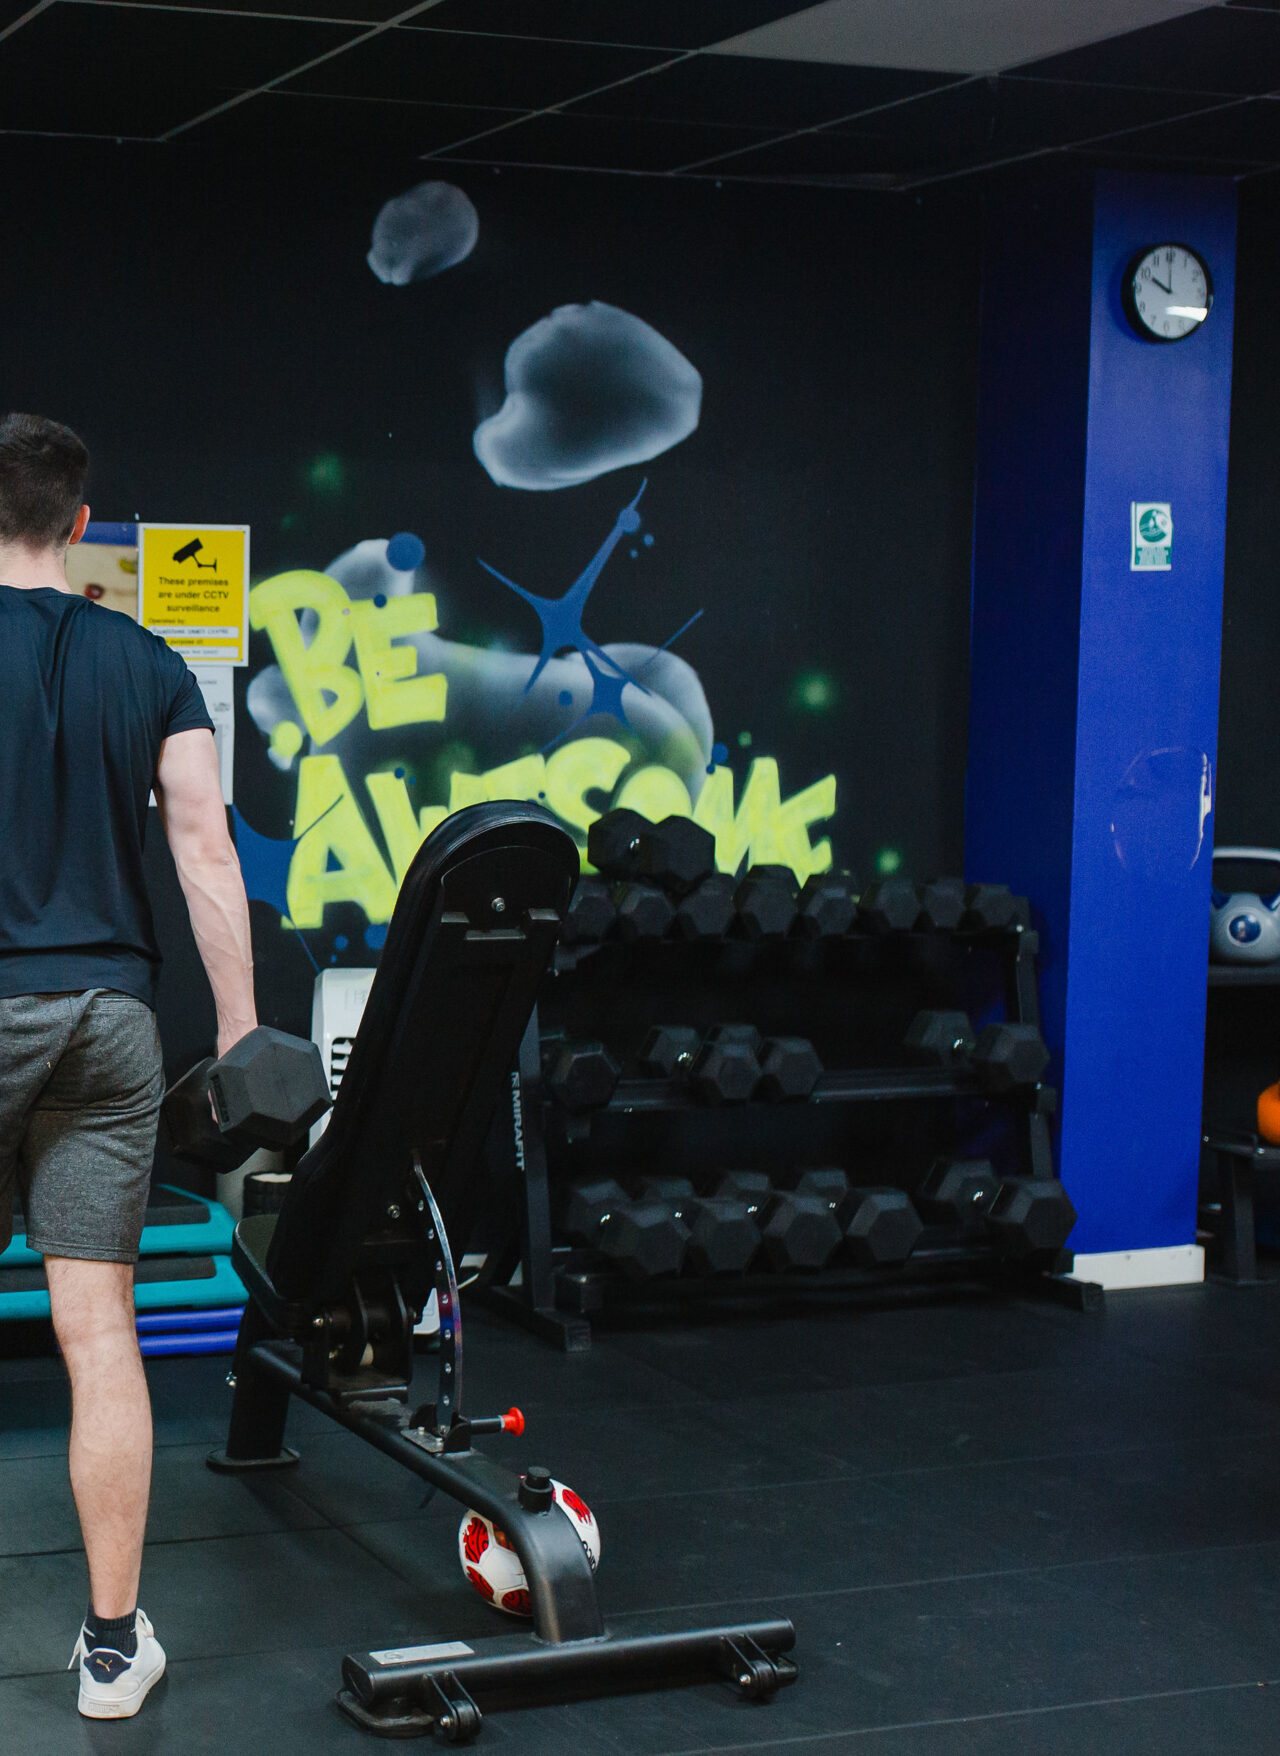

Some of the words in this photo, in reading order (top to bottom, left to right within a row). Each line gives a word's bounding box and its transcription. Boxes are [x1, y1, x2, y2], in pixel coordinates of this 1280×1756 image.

[1141, 266, 1152, 281] 10
[158, 576, 185, 586] These
[187, 578, 229, 587] premises
[158, 591, 173, 599] are
[175, 591, 201, 599] under
[203, 590, 229, 600] CCTV
[166, 605, 220, 613] surveillance
[250, 569, 447, 746] BE
[512, 1089, 525, 1171] MIRAFIT
